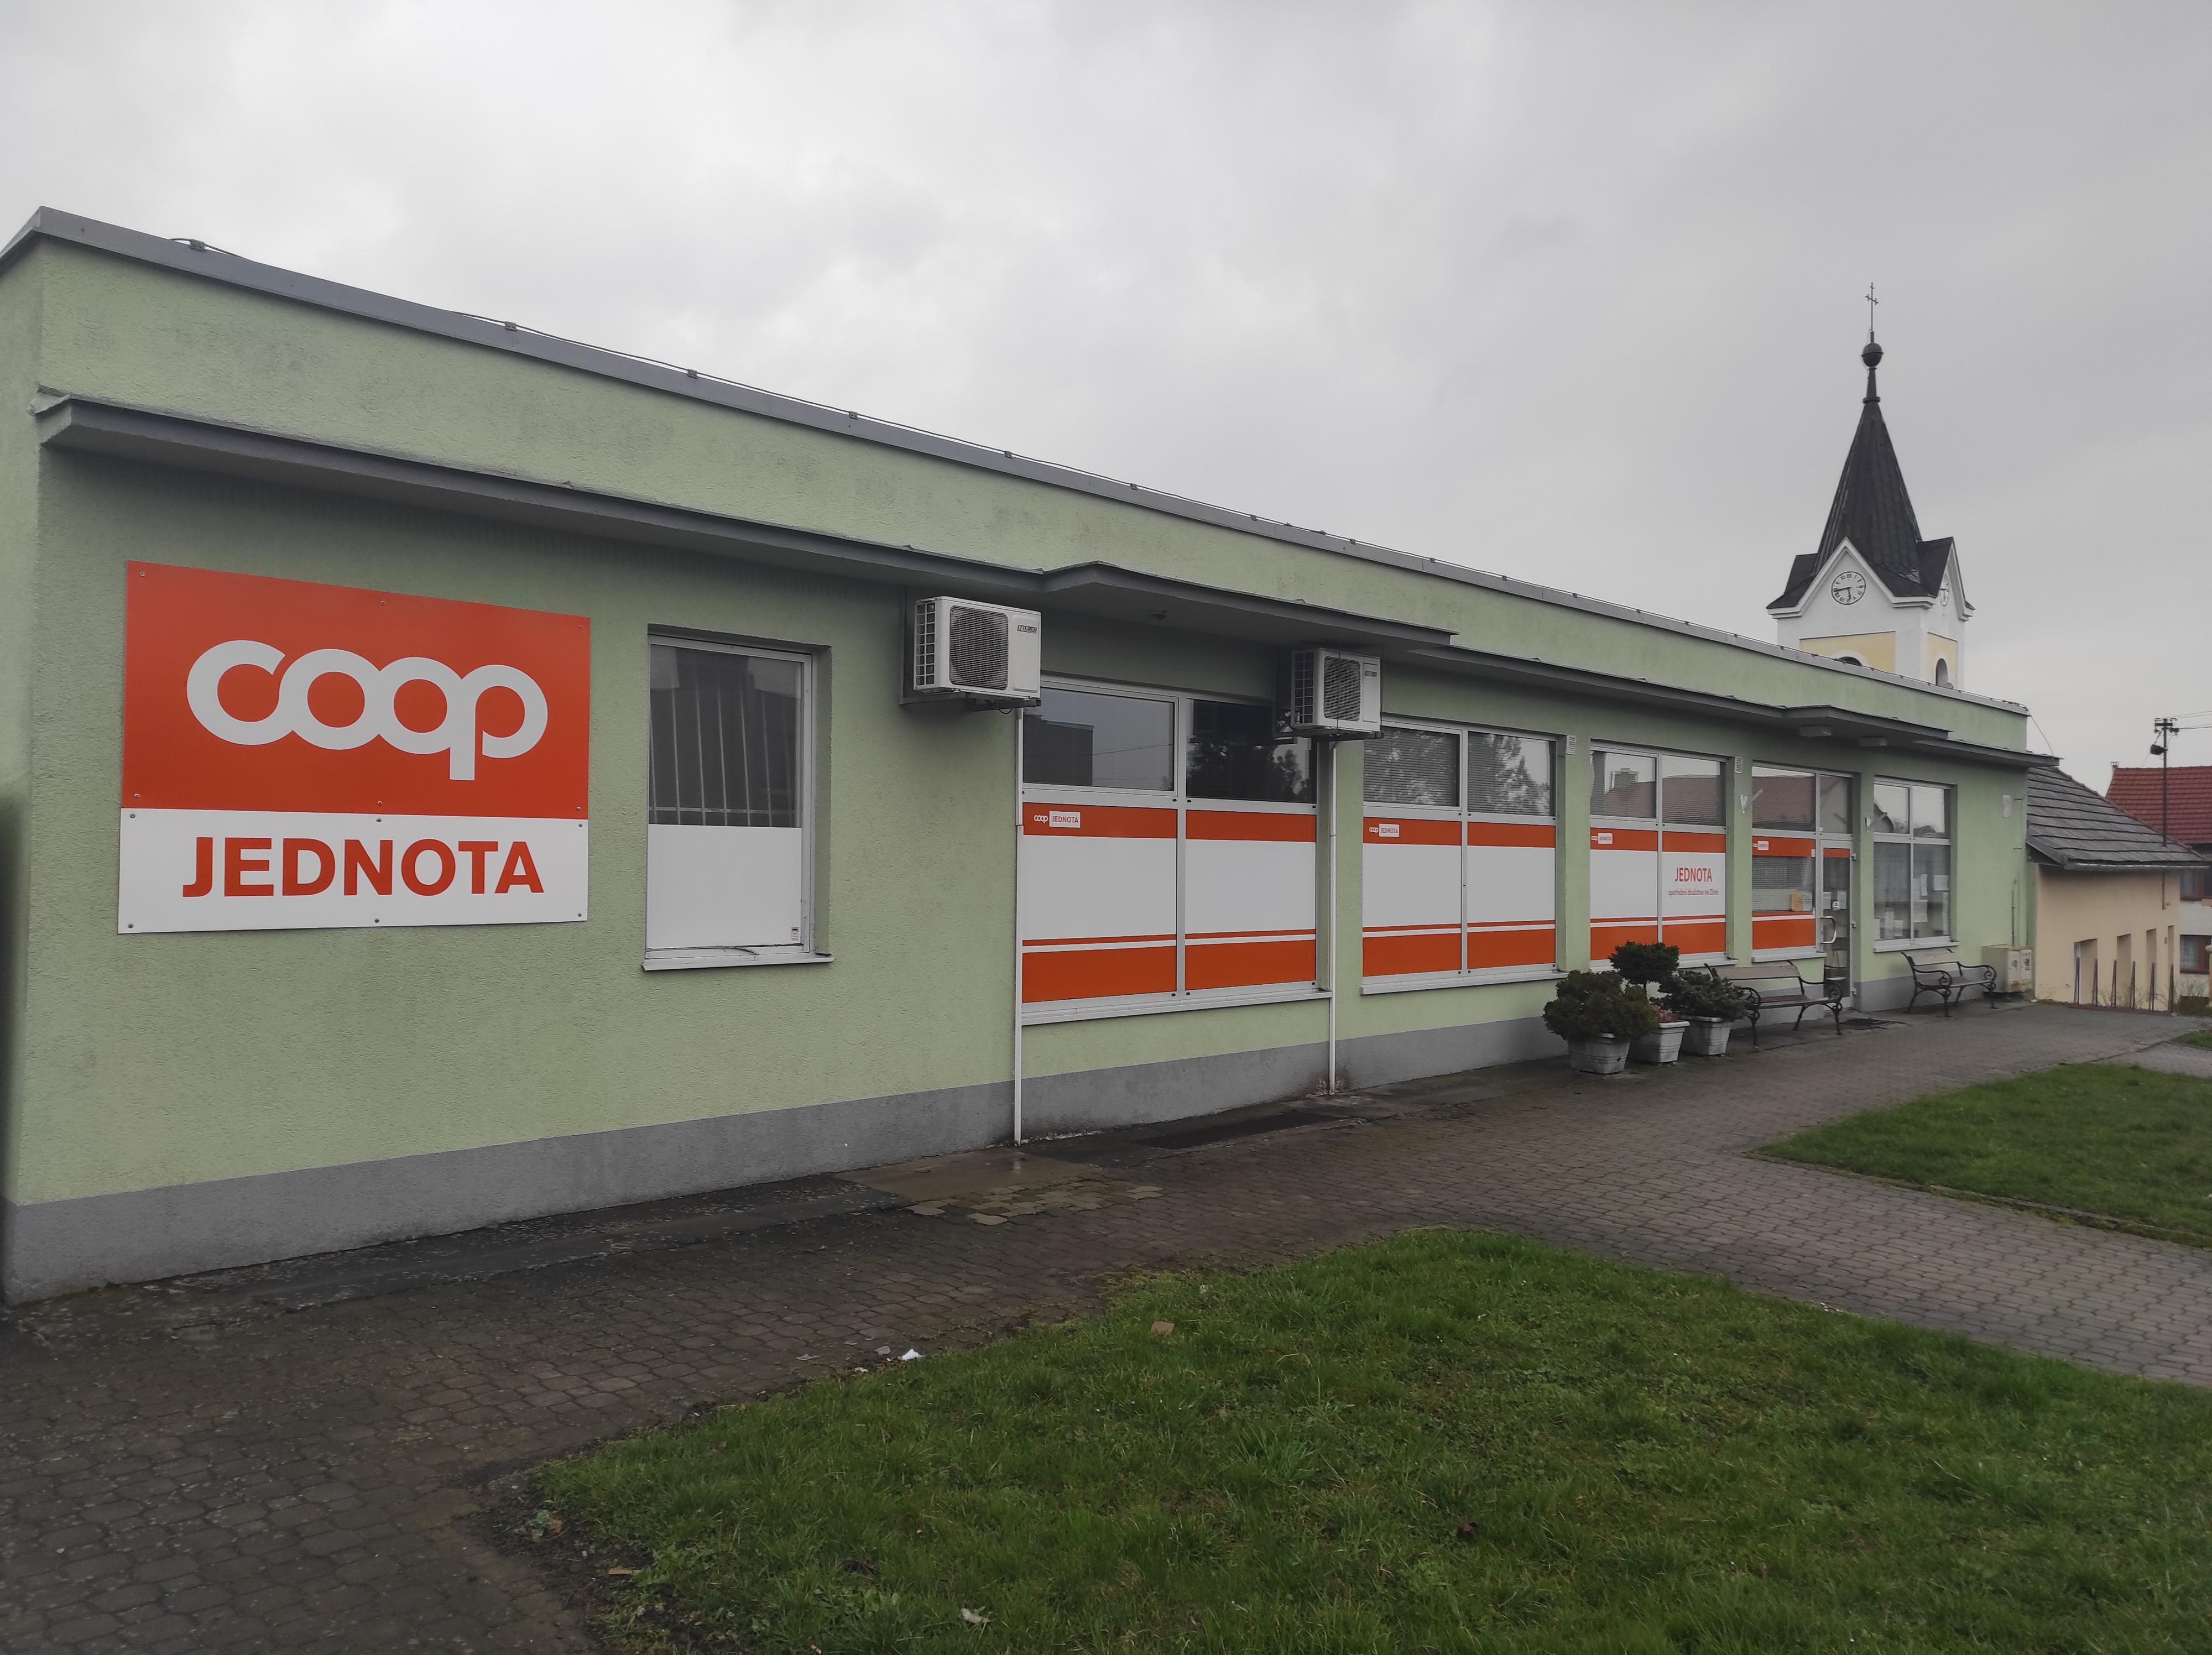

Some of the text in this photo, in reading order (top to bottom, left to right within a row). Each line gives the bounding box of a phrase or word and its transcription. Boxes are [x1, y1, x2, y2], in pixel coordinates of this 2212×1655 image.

[186, 640, 548, 781] coop
[182, 837, 544, 897] JEDNOTA
[1675, 868, 1712, 882] JEDNOTA
